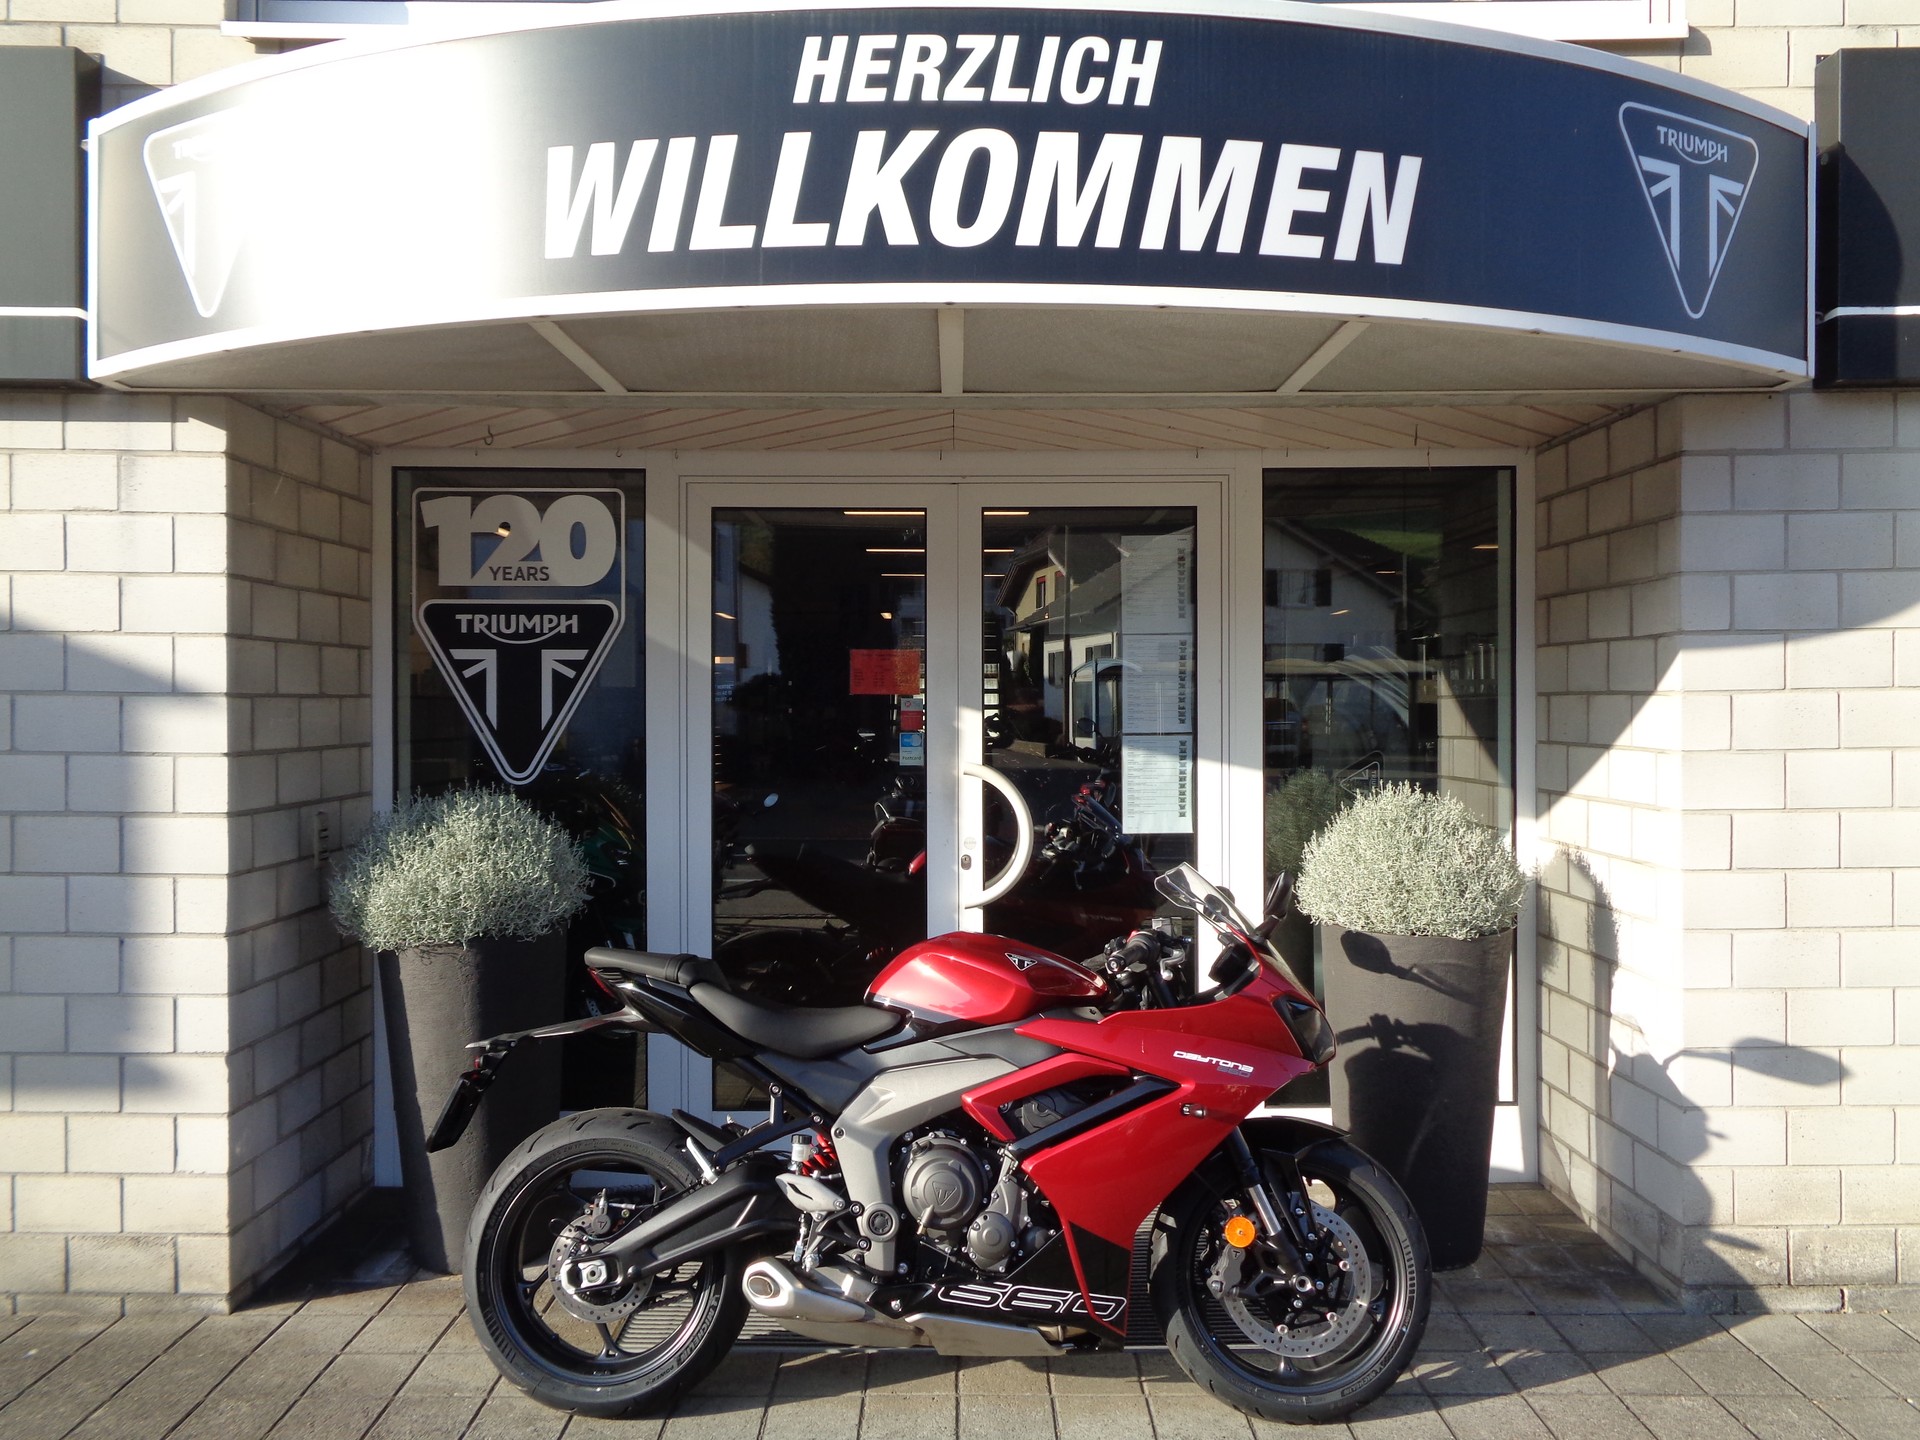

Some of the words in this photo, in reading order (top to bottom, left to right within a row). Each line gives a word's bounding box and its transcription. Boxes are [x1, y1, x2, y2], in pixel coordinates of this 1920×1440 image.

[792, 34, 1163, 108] HERZLICH
[1656, 125, 1728, 165] TRIUMPH
[544, 128, 1423, 266] WILLKOMMEN
[420, 494, 617, 586] 120
[488, 566, 550, 582] YEARS
[455, 614, 578, 644] TRIUMPH
[937, 1281, 1128, 1322] 660
[680, 1308, 716, 1364] MICHELIN
